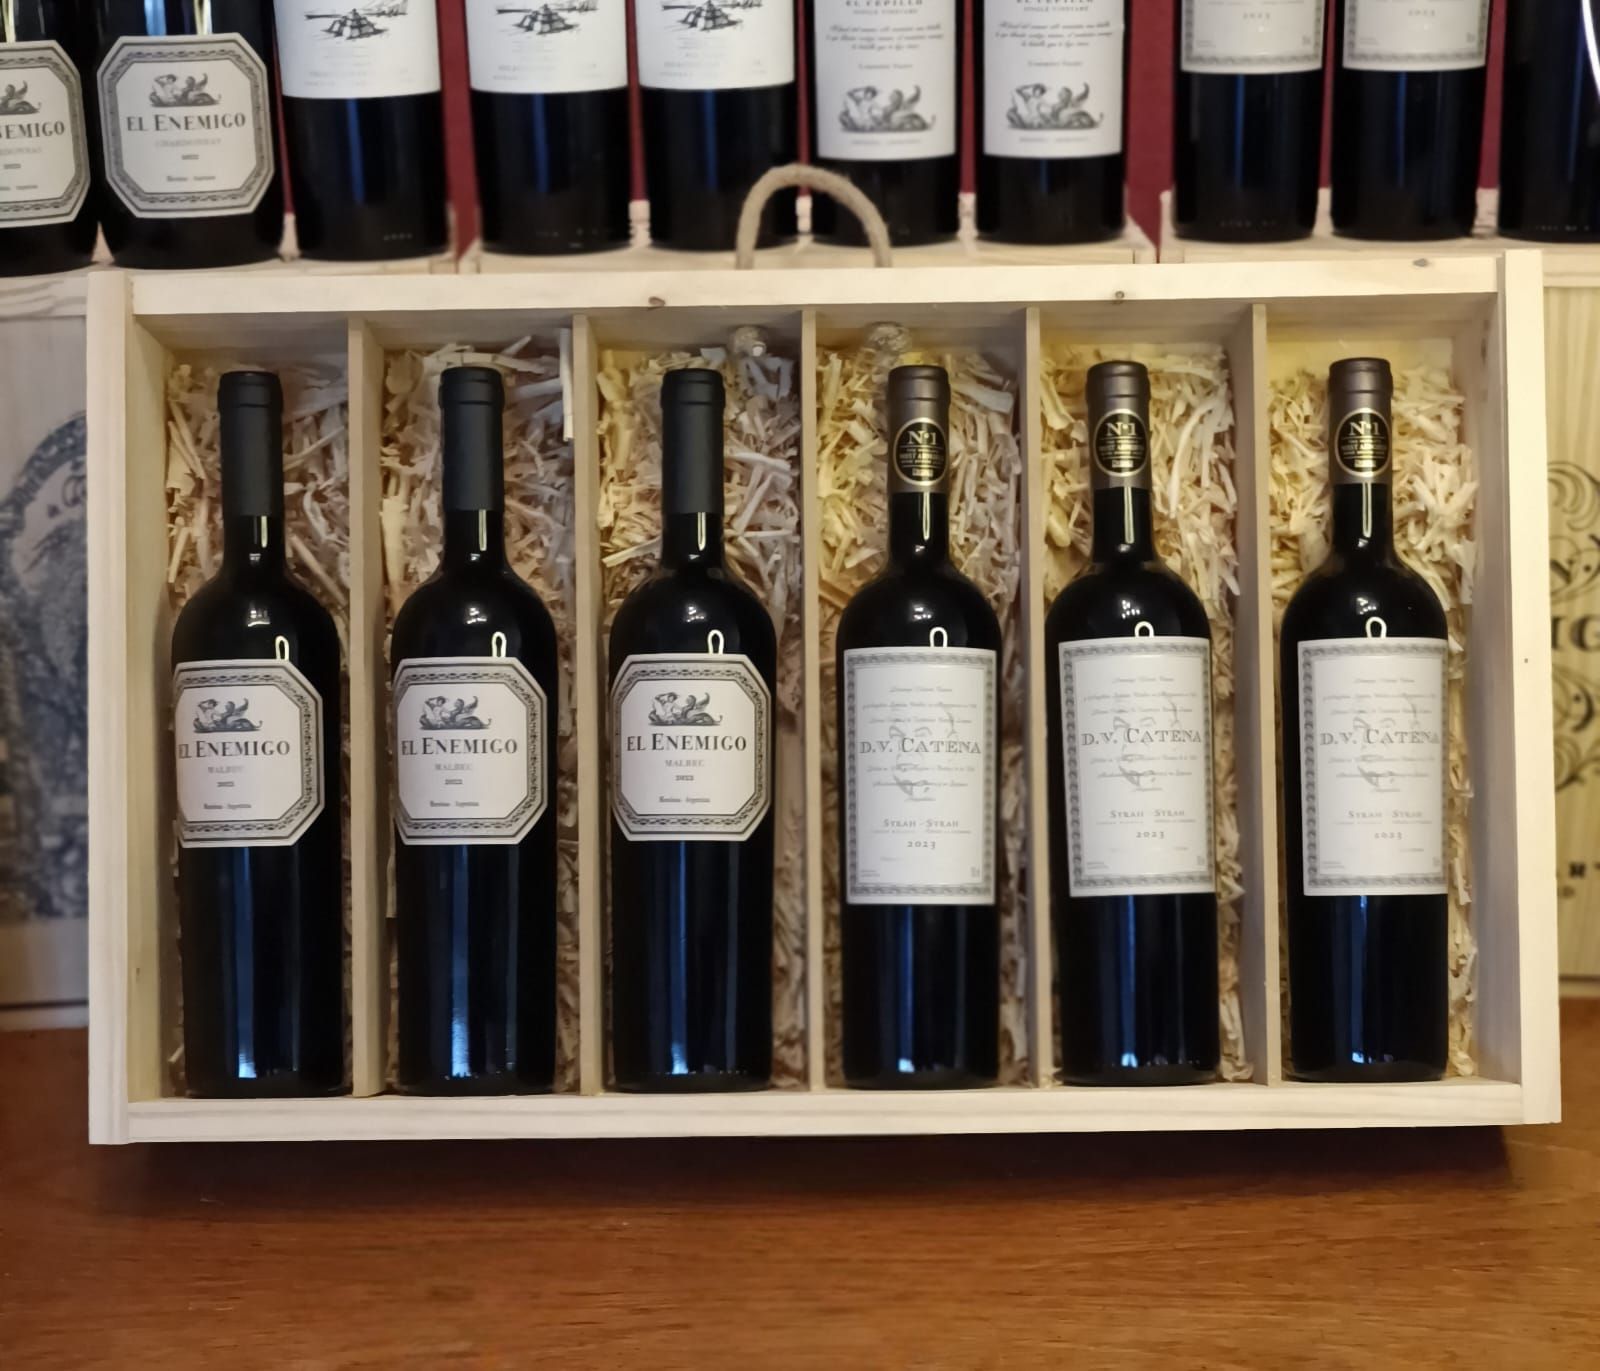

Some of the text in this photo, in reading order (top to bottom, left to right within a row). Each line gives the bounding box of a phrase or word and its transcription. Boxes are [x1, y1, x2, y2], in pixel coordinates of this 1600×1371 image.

[0, 120, 66, 140] EMIGO
[126, 112, 246, 132] EL ENEMIGO
[401, 736, 519, 756] EL ENEMIGO
[625, 732, 748, 752] EL ENEMIGO
[858, 737, 982, 754] D.V. CATENA
[1080, 727, 1202, 746] D.V. CATENA
[1319, 728, 1440, 746] D.V. CATENA
[195, 739, 290, 758] ENEMIGO
[1135, 830, 1166, 840] 2023
[906, 840, 936, 851] 2023
